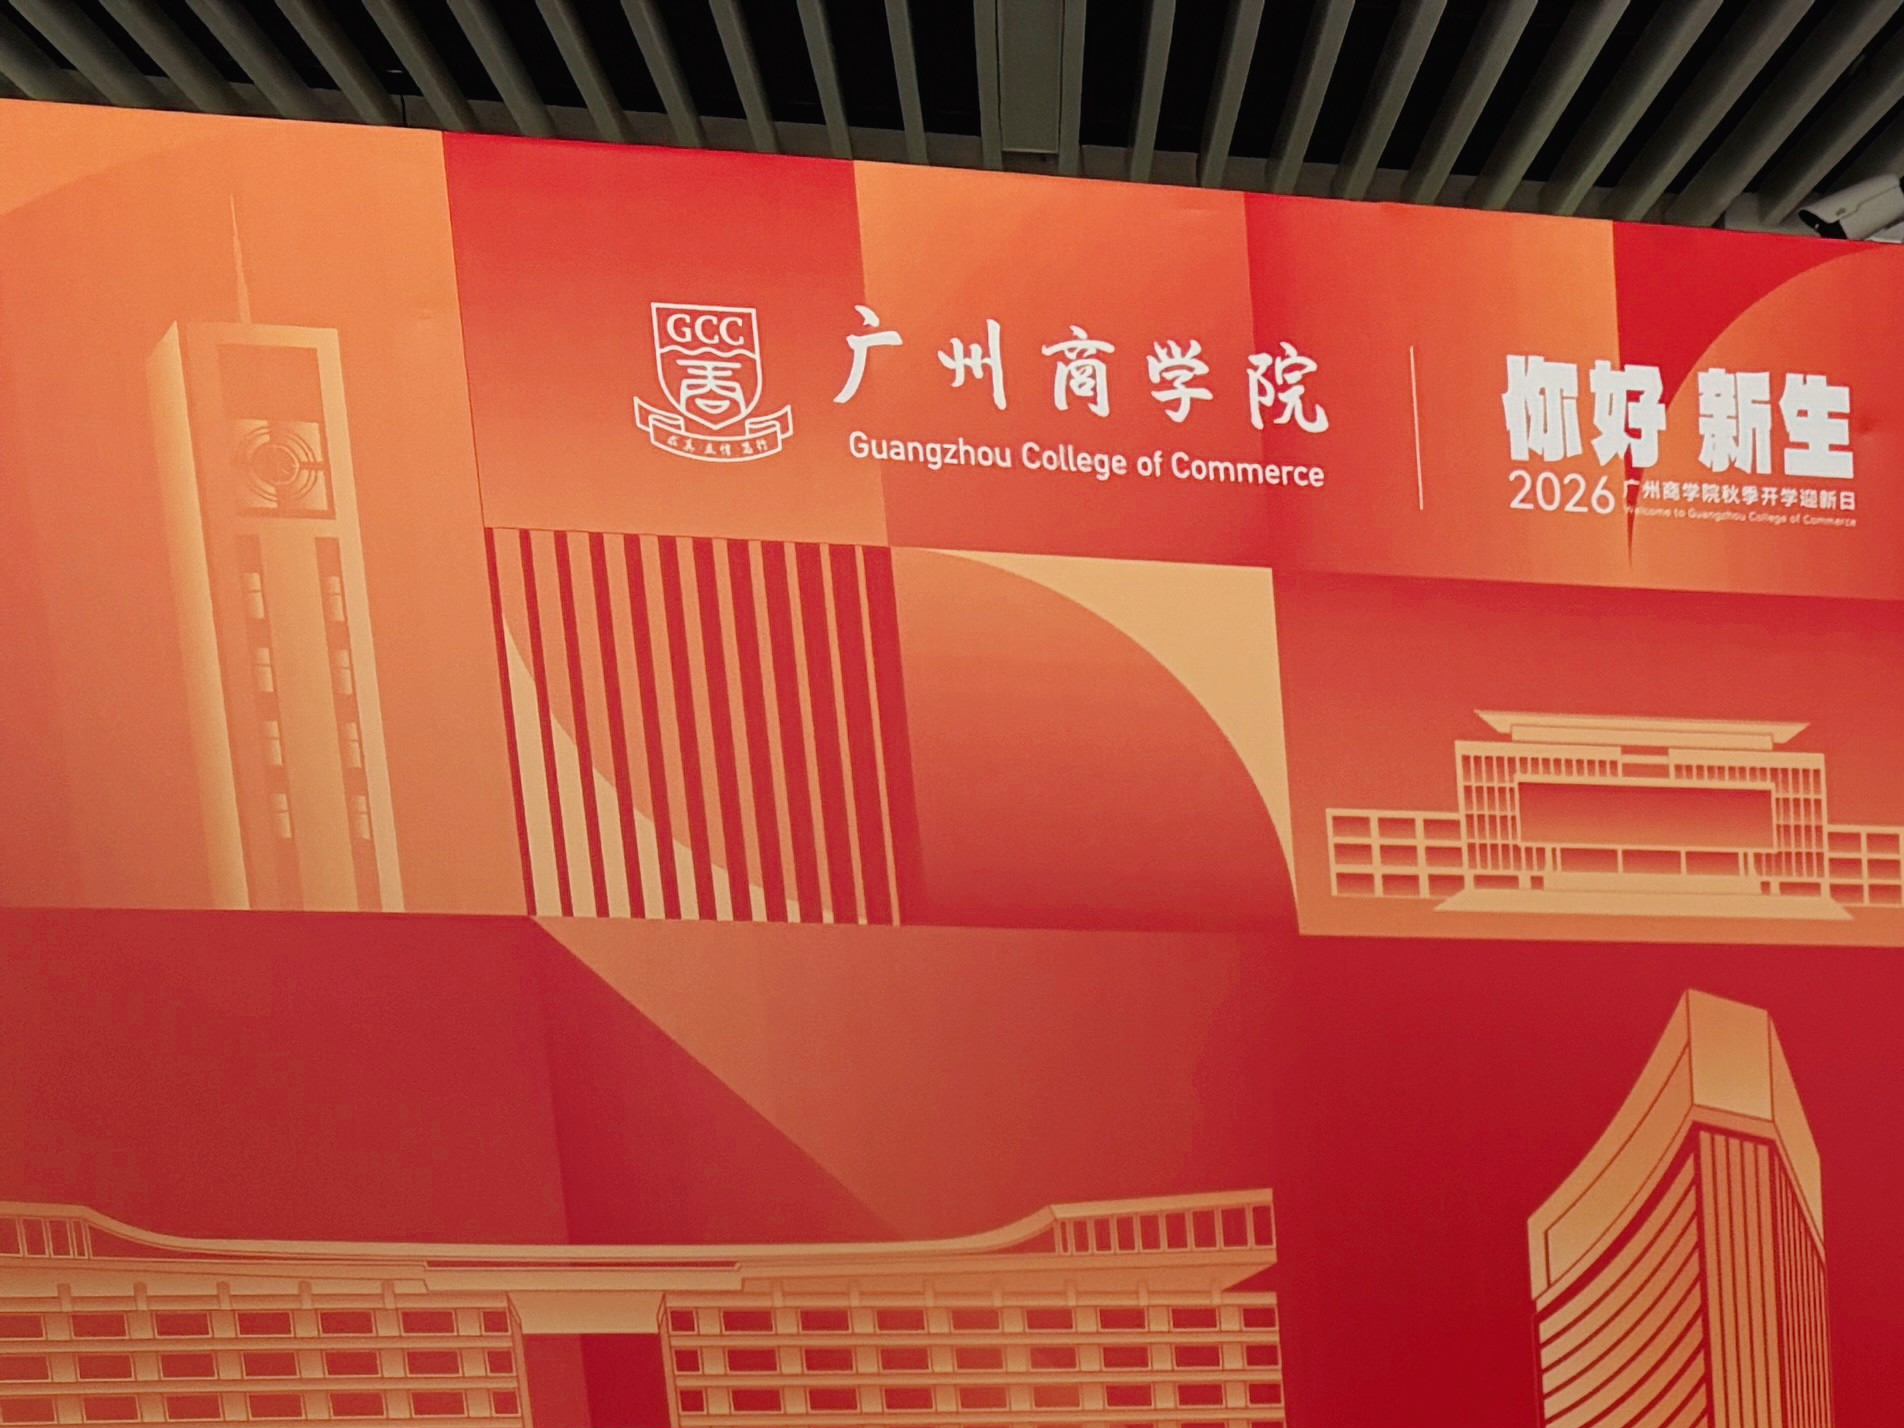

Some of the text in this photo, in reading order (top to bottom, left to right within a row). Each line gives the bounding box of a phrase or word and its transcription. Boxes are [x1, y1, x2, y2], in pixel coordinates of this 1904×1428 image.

[666, 313, 745, 346] GCC
[833, 305, 1329, 433] 广州商学院
[1502, 354, 1855, 479] 你好 新生
[849, 430, 1325, 488] Guangzhou College of Commerce
[1508, 469, 1616, 514] 2026
[1623, 479, 1856, 511] 广州商学院秋季开学迎新日
